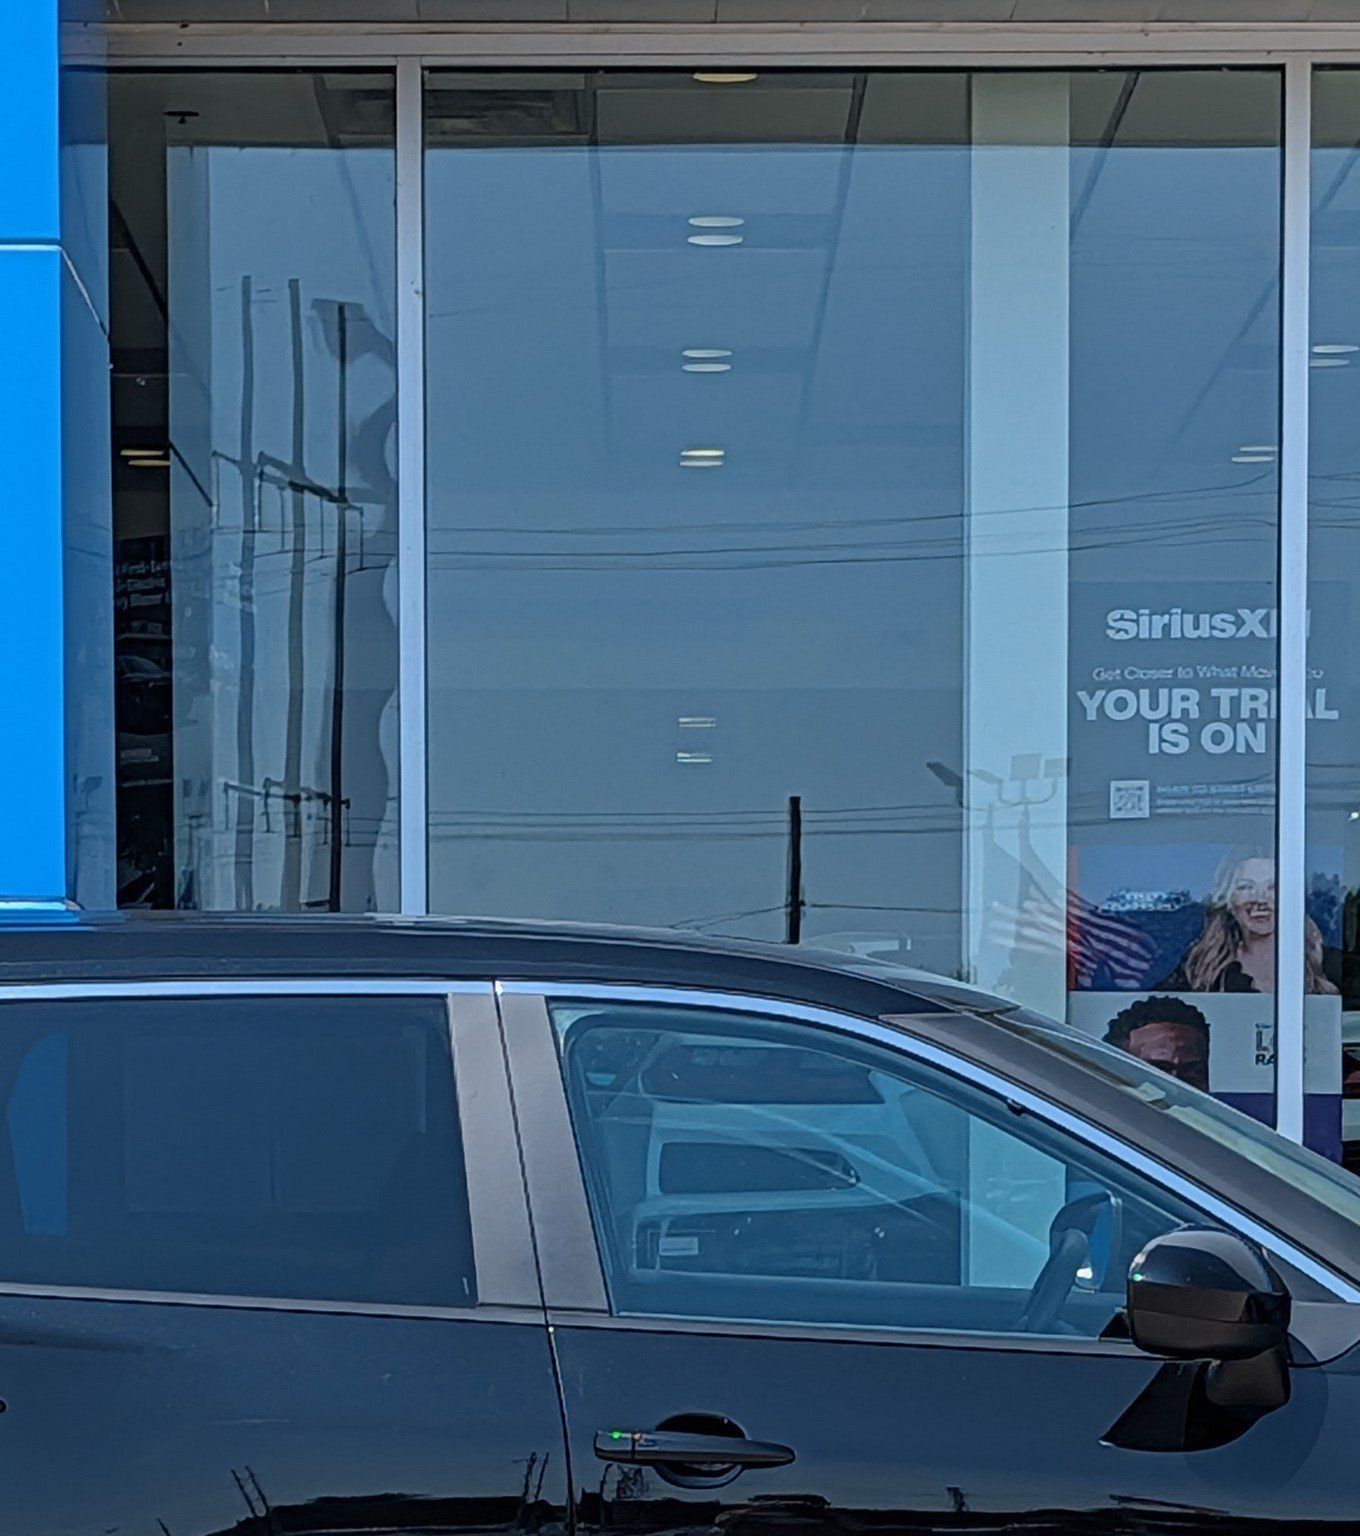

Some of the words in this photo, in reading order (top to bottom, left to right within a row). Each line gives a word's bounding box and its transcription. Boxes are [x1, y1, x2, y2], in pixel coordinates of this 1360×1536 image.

[1106, 607, 1311, 640] SiriusX
[1077, 688, 1200, 721] YOUR
[1211, 688, 1339, 720] TRIL
[1148, 722, 1190, 754] IS
[1200, 722, 1267, 754] ON
